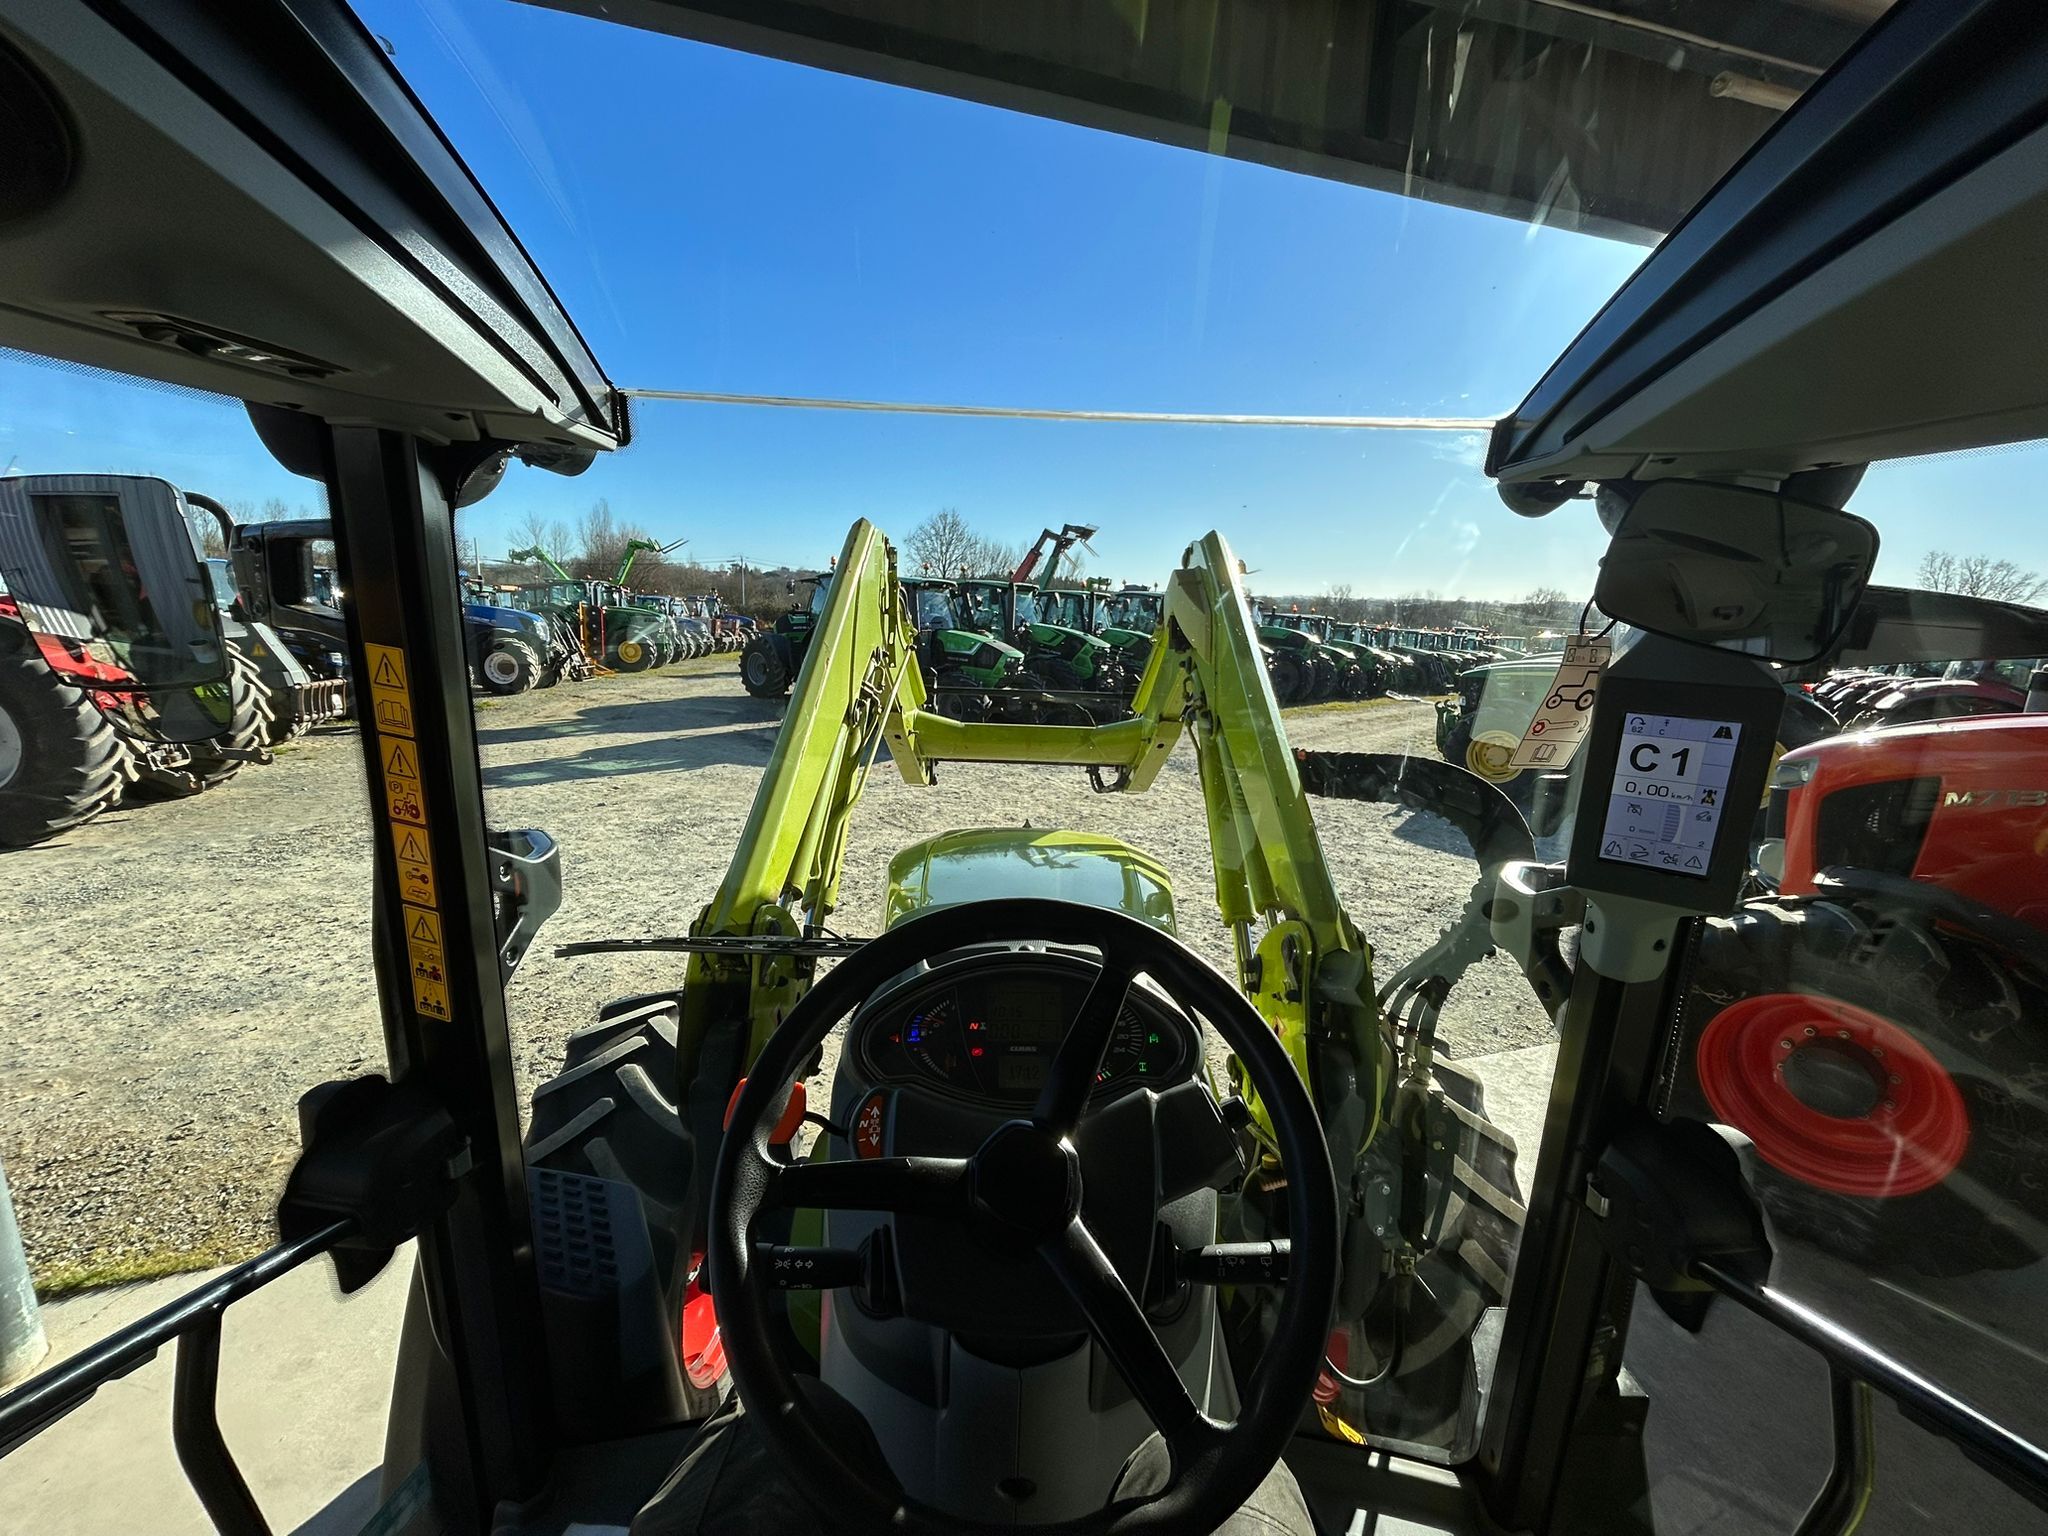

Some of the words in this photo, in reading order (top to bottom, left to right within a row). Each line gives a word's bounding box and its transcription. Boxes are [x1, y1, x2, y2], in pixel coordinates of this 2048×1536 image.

[1629, 743, 1661, 773] C
[1671, 747, 1690, 777] 1
[859, 1120, 869, 1128] N
